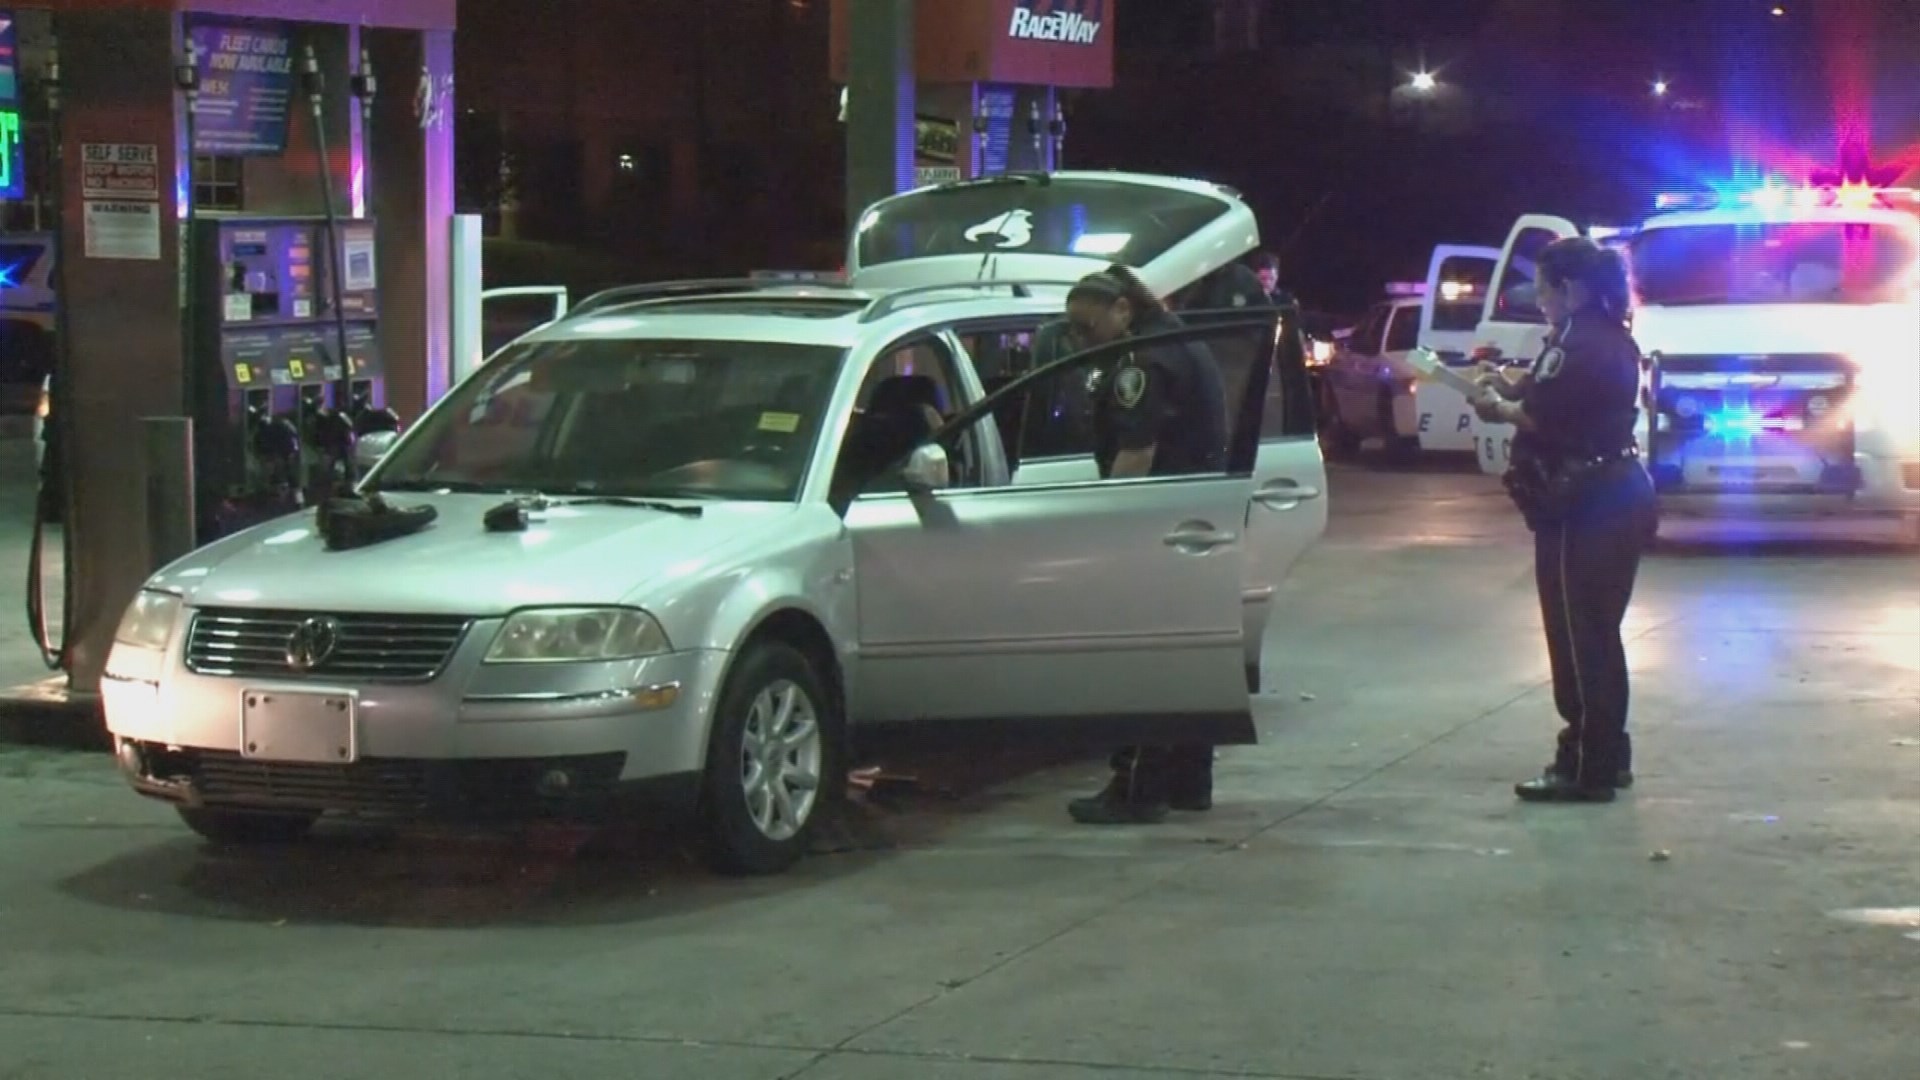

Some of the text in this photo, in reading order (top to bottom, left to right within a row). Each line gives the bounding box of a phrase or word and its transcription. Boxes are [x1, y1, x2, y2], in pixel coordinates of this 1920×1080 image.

[220, 35, 251, 52] FLEET
[85, 145, 154, 162] SELF SERVE
[92, 203, 151, 214] WARNING
